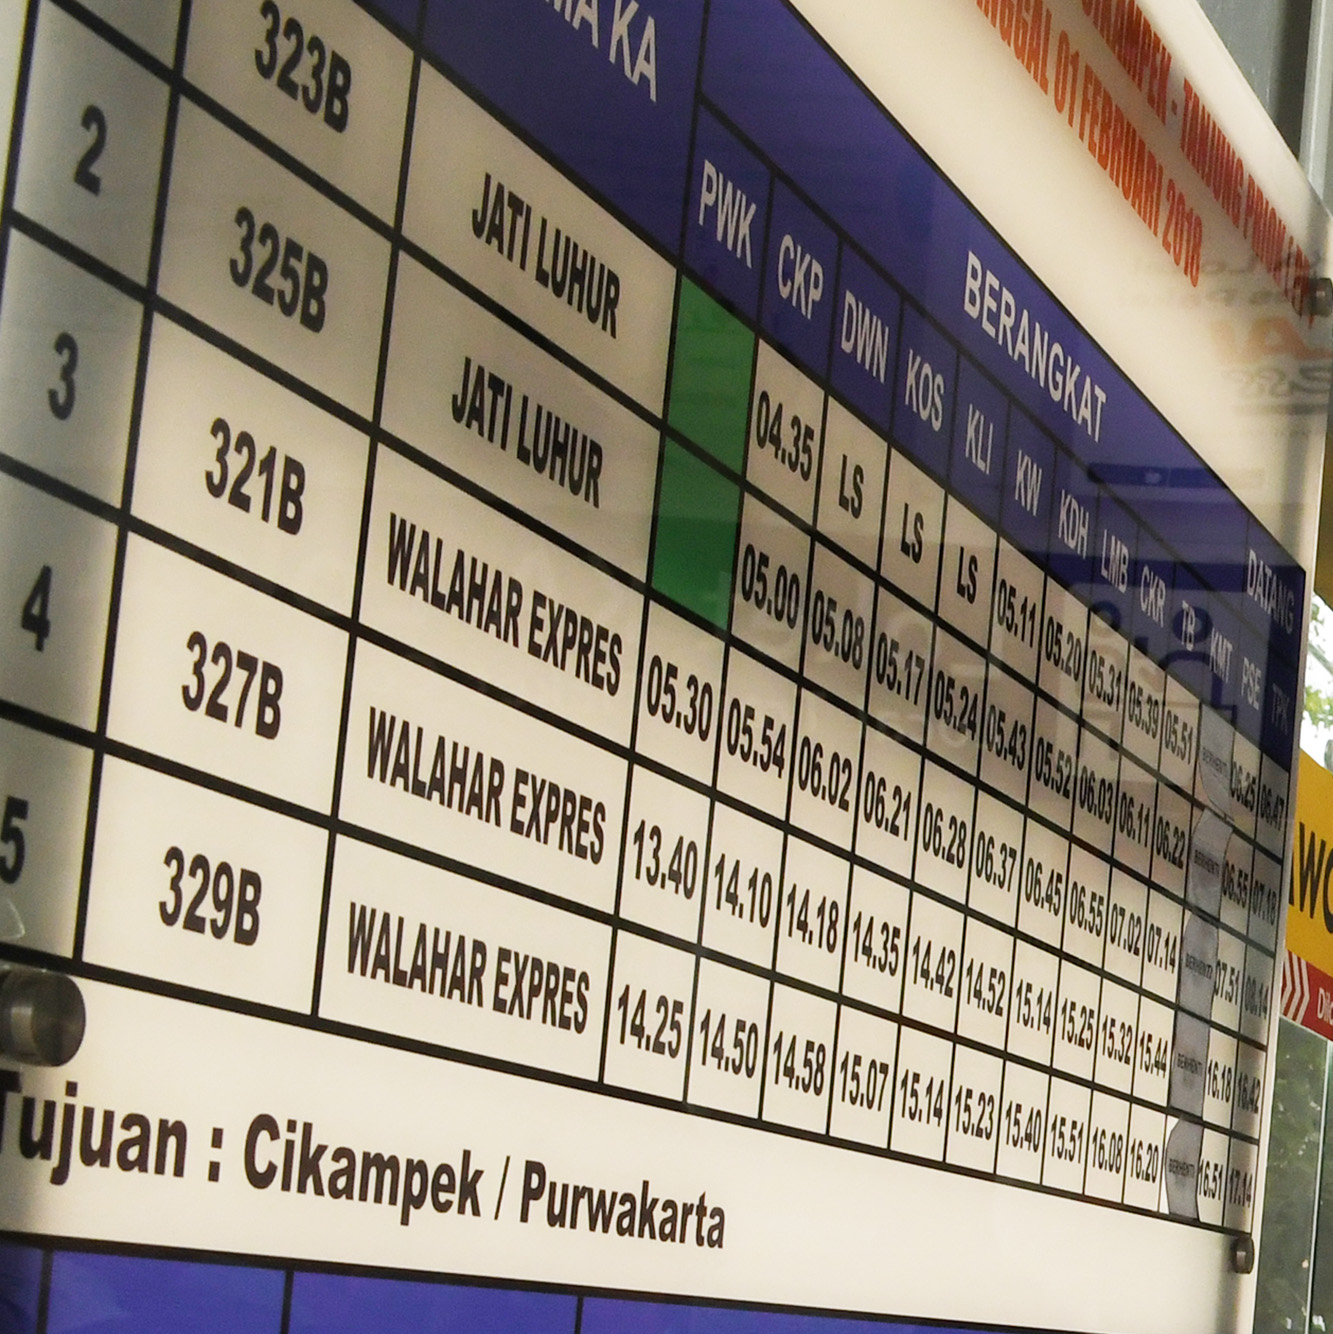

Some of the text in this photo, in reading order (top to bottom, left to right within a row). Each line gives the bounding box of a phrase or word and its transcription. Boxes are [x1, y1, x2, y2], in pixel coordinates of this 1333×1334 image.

[254, 0, 621, 338] 323B JATI LUHUR
[609, 0, 657, 103] KA
[1054, 30, 1079, 128] 01
[1079, 63, 1164, 238] FEBRUARI
[74, 105, 603, 508] 2 325B JATI LUHUR
[698, 159, 757, 268] PWK
[777, 233, 825, 321] CKP
[840, 289, 889, 383] DWN
[904, 348, 945, 431] KOS
[965, 402, 994, 475] KLI
[1014, 449, 1042, 516] KW
[1057, 488, 1088, 560] KDH
[1100, 529, 1131, 594] LMB
[1139, 565, 1167, 628] CKR
[963, 250, 1106, 443] BERANGKAT
[755, 389, 814, 483] 04.35
[48, 332, 787, 779] 3 321B WALAHAR EXPRES 05.30 05.54
[741, 542, 801, 632] 05.00
[20, 565, 773, 928] 4 327B WALAHAR EXPRES 13.40 14.10
[0, 796, 684, 1059] 5 329B WALAHAR EXPRES 14.25
[0, 1068, 726, 1250] Tujuan Cikampek Purwakarta
